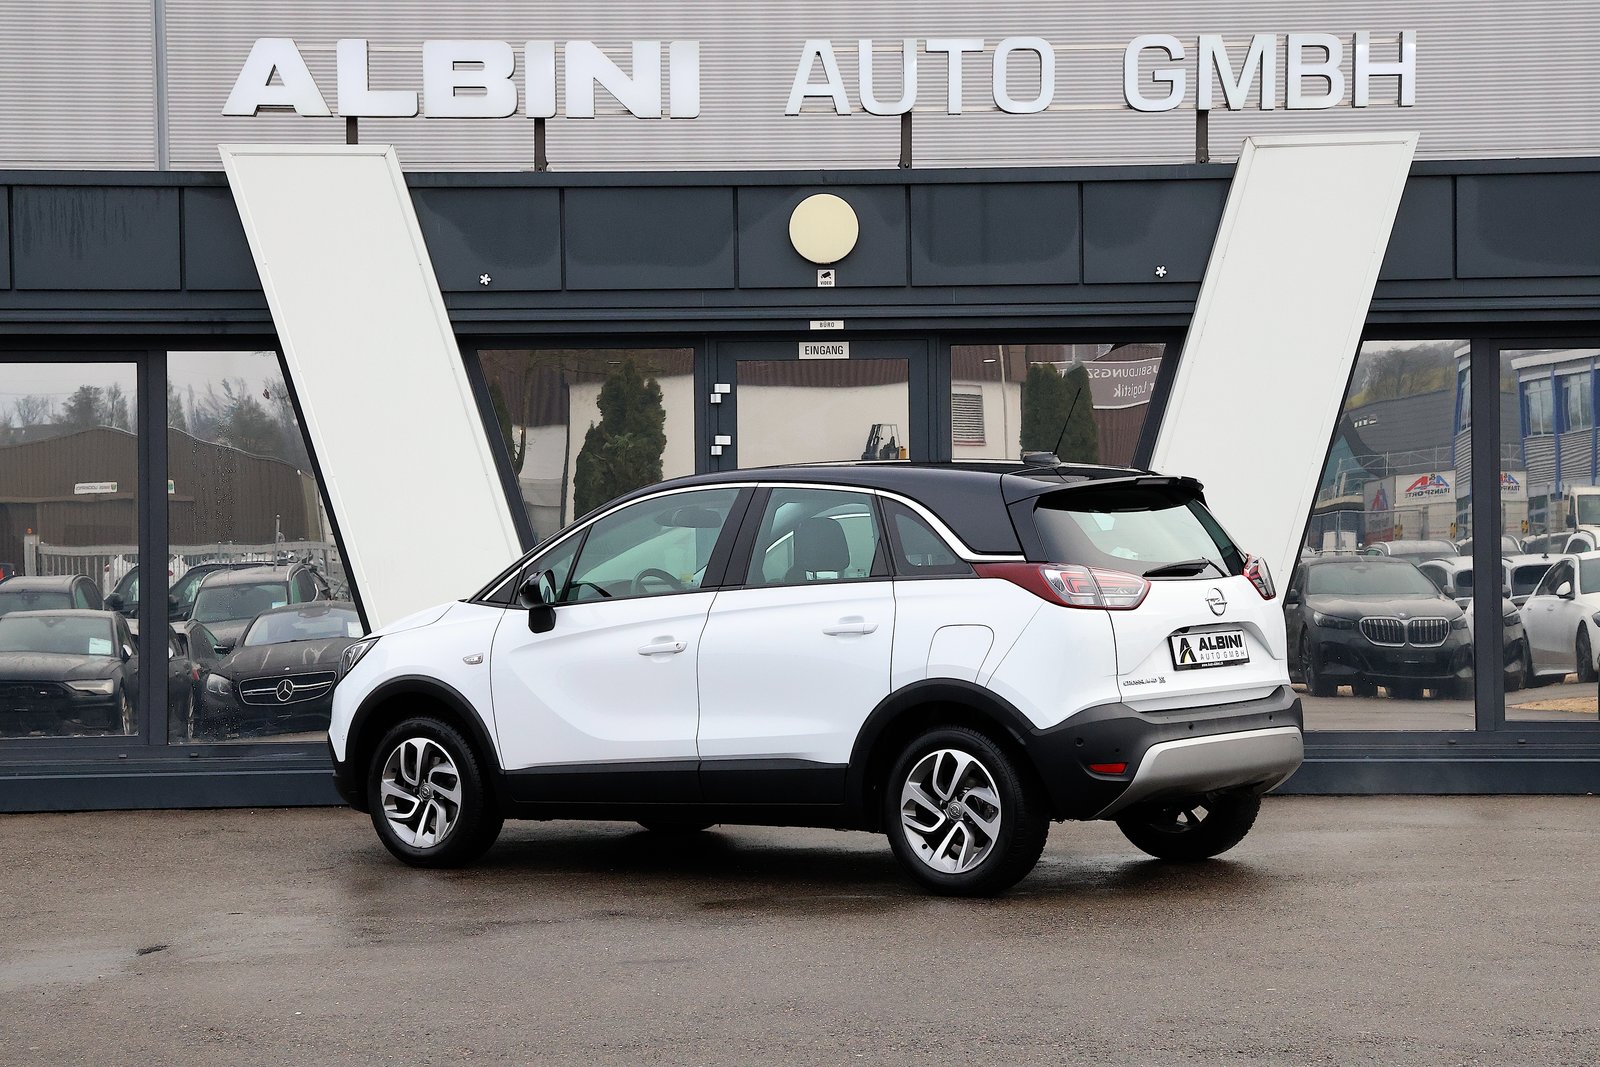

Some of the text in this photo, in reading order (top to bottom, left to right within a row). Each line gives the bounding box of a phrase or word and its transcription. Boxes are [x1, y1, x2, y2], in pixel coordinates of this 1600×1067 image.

[221, 30, 1417, 119] ALBINI AUTO GMBH
[804, 345, 844, 356] EINGANG
[1199, 634, 1243, 652] ALBINI
[1200, 650, 1245, 661] AUTO GMBH
